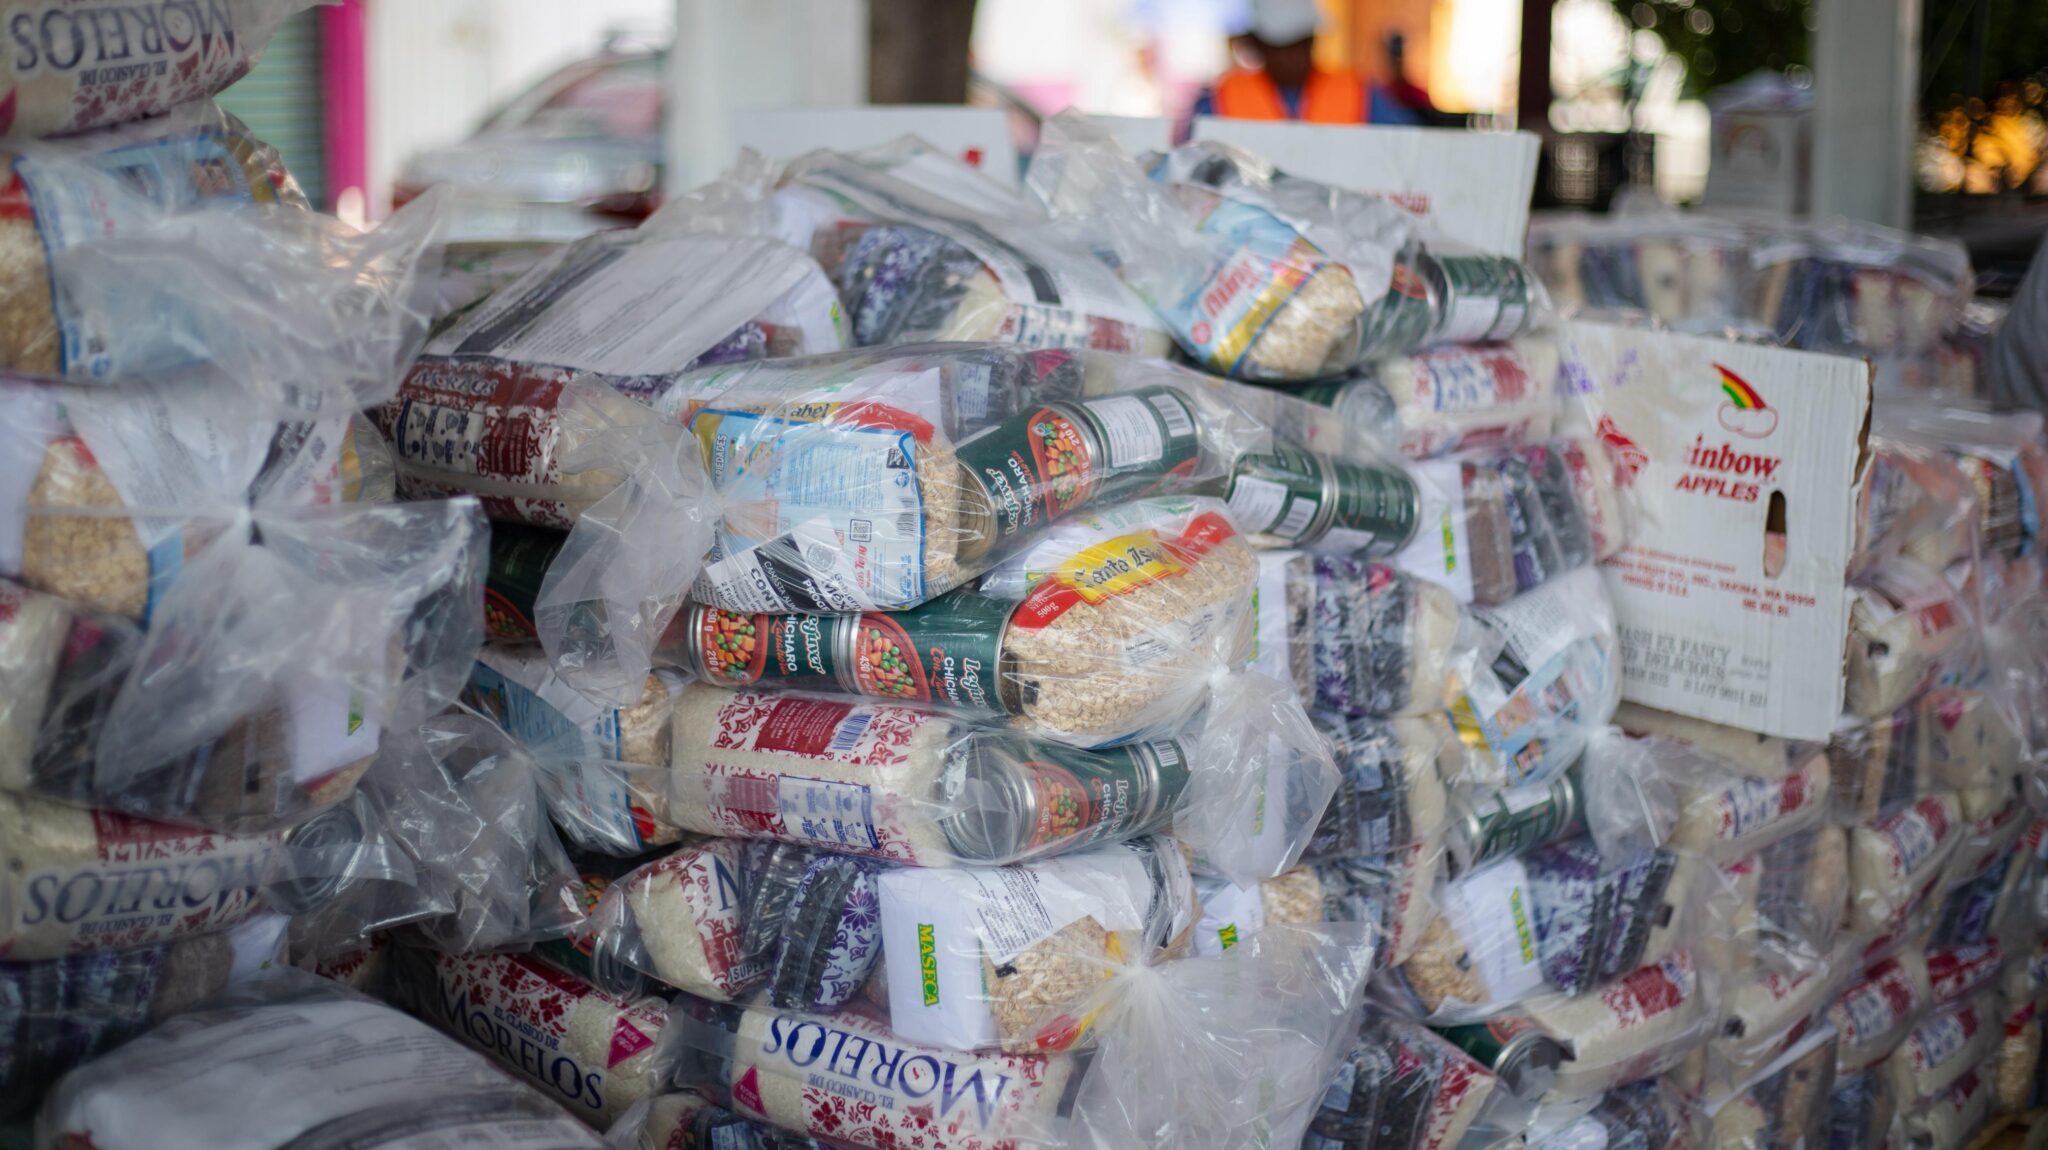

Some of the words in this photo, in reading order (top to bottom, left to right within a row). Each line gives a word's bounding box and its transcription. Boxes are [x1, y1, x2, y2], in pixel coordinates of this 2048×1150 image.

[10, 0, 236, 71] MORELOS
[78, 69, 99, 87] DE
[153, 60, 167, 77] EL
[1064, 429, 1081, 447] 210
[1675, 475, 1760, 502] APPLES
[834, 573, 862, 609] Gobiern
[784, 613, 799, 672] HÍCHARO
[800, 613, 827, 675] eguver
[860, 655, 870, 672] 430
[944, 656, 963, 706] CHÍCHA
[22, 847, 272, 925] MORELOS
[917, 922, 941, 1008] MASECA
[439, 973, 603, 1110] MORELOS
[494, 1005, 508, 1018] EL
[504, 1014, 545, 1044] CLASICO
[544, 1036, 560, 1051] DE
[764, 1013, 1013, 1130] MORELOS
[808, 1071, 825, 1088] DE
[826, 1078, 873, 1104] CLASICO
[873, 1092, 894, 1110] EL
